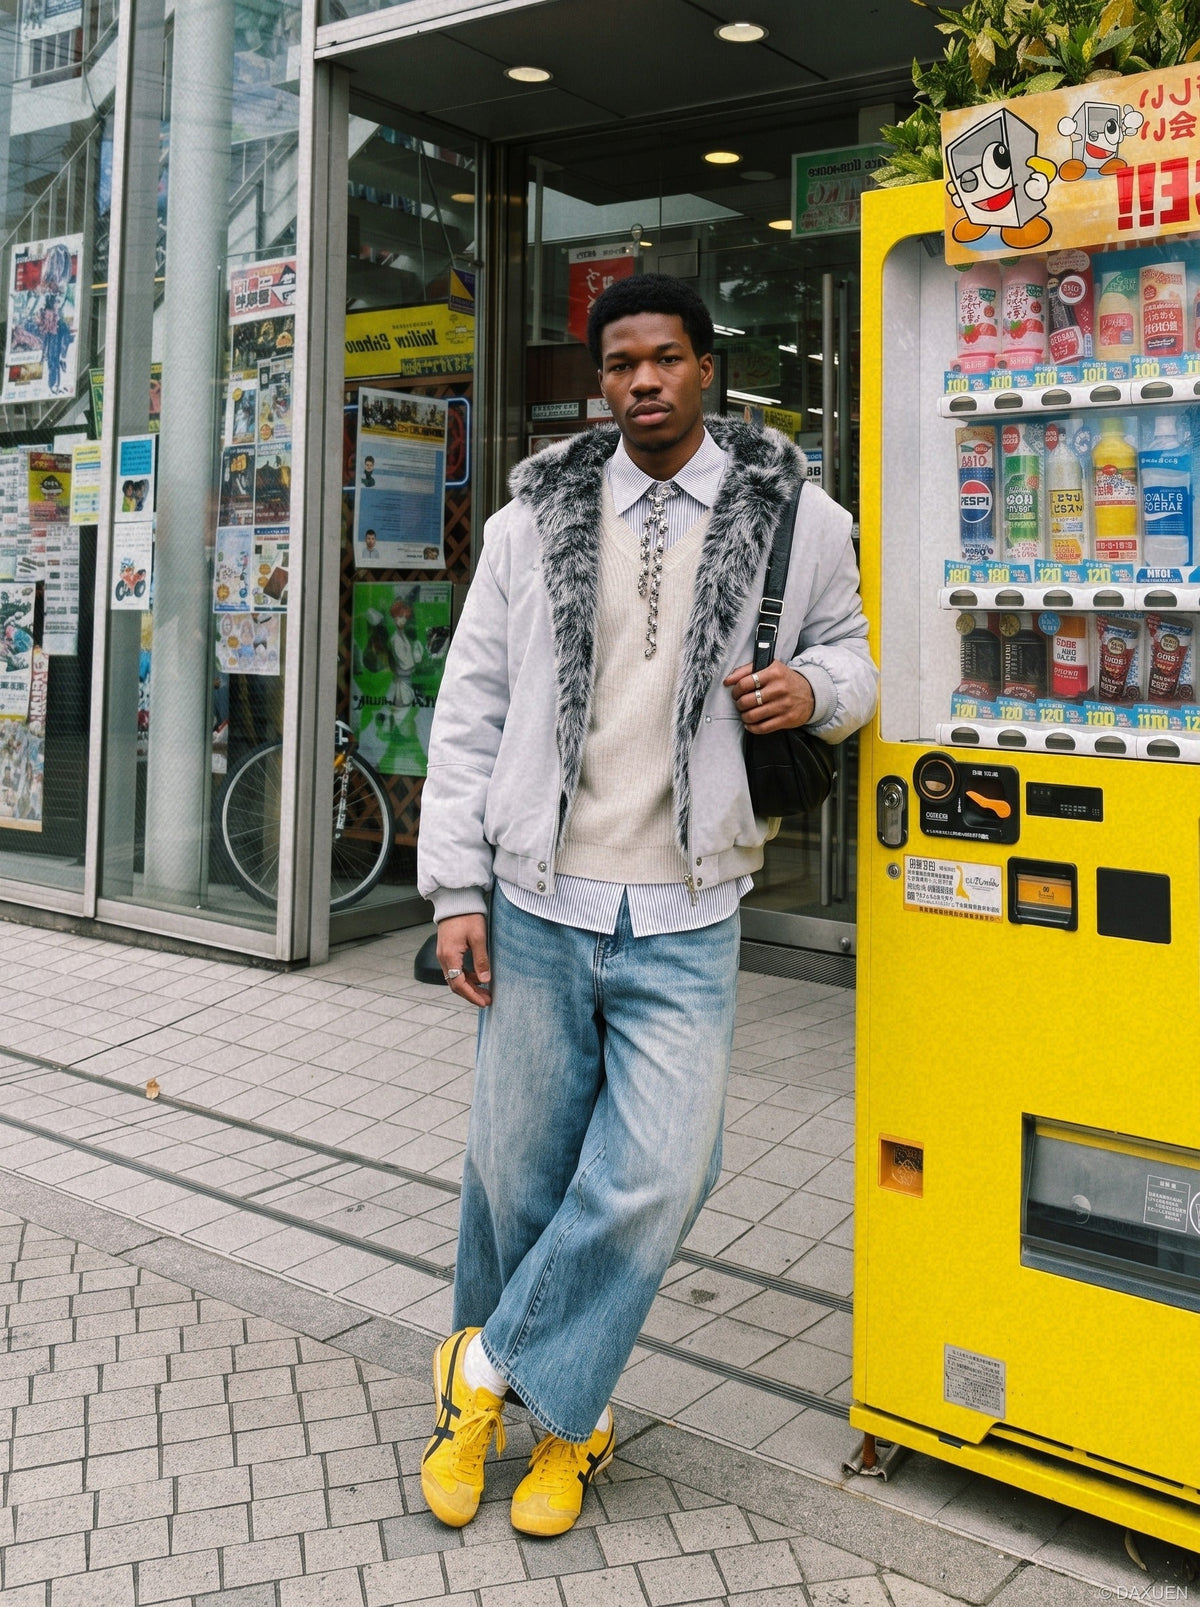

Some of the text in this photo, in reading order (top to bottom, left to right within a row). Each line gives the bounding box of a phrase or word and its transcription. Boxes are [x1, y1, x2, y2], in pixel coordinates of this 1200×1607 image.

[1134, 362, 1160, 378] 100
[946, 379, 968, 393] 100
[1039, 568, 1061, 583] 120
